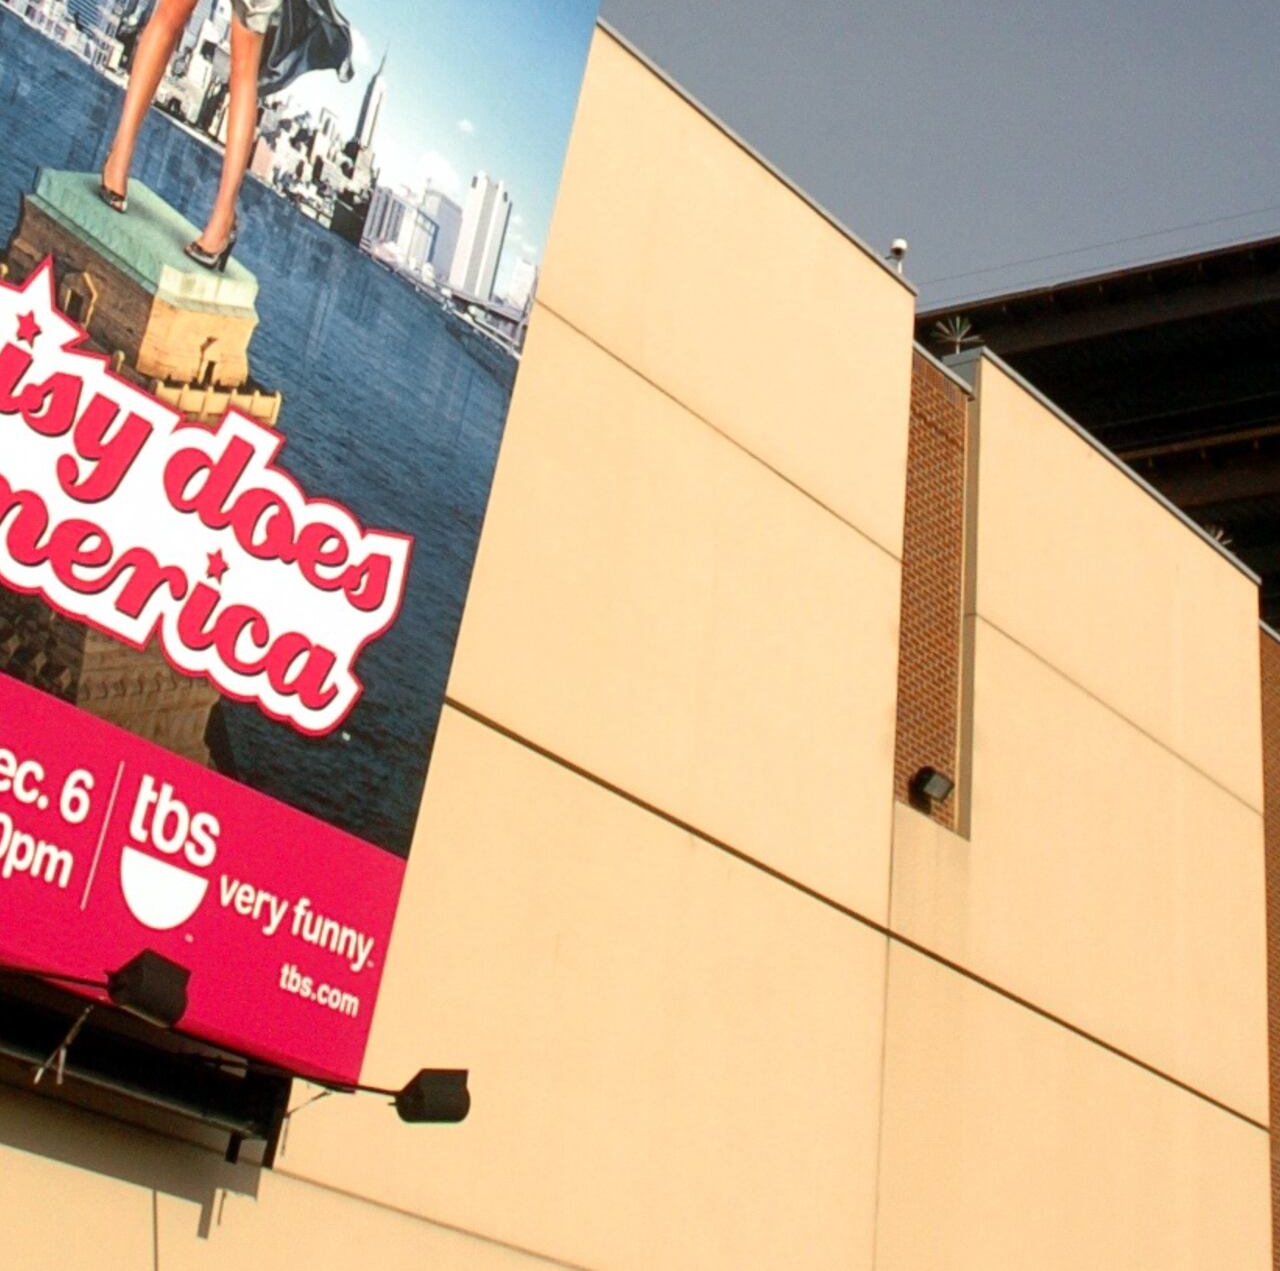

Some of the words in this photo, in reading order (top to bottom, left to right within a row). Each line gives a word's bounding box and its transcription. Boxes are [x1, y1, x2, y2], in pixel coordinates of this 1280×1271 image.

[162, 433, 394, 611] does
[60, 769, 94, 823] 6
[129, 774, 220, 866] tbs
[220, 874, 288, 936] very
[280, 963, 360, 1018] tbs.com
